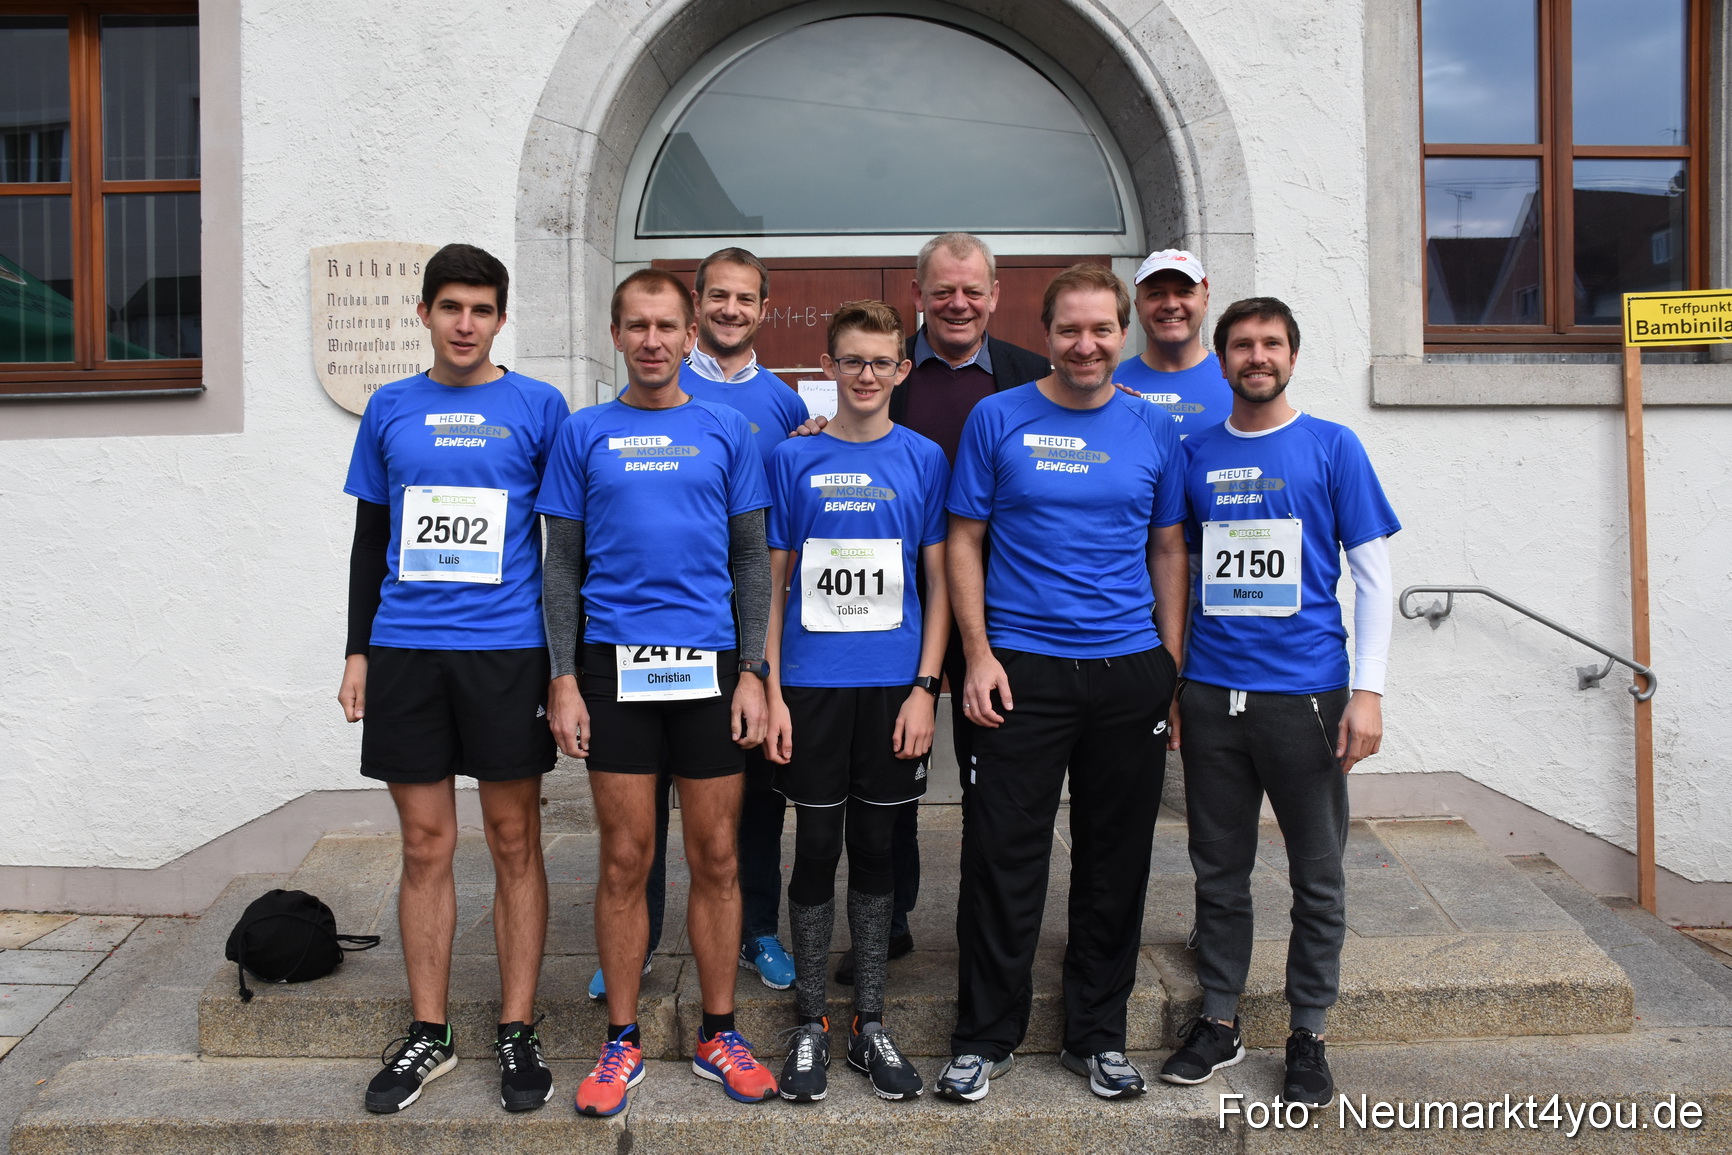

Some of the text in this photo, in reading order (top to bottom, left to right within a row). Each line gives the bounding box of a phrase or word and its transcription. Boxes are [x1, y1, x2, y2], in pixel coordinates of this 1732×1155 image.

[327, 259, 420, 278] Rathaus
[327, 293, 368, 307] Neubau
[375, 295, 389, 306] um
[1660, 301, 1732, 316] Treffpunkt
[327, 315, 420, 331] Zerstörung 1945
[328, 338, 421, 353] Wiederaufbau 1957
[327, 361, 421, 376] Generalsanierung
[439, 414, 476, 423] HEUTE
[448, 425, 502, 436] MORGEN
[434, 437, 486, 448] BEWEGEN
[623, 437, 662, 446] HEUTE
[1038, 436, 1076, 448] HEUTE
[636, 447, 690, 456] MORGEN
[1047, 448, 1101, 462] MORGEN
[625, 461, 679, 472] BEWEGEN
[1035, 460, 1089, 474] BEWEGEN
[824, 475, 862, 484] HEUTE
[1218, 469, 1254, 480] HEUTE
[1228, 480, 1277, 491] MORGEN
[836, 486, 887, 498] MORGEN
[441, 496, 476, 504] BOCK
[1215, 494, 1263, 506] BEWEGEN
[824, 501, 876, 512] BEWEGEN
[416, 516, 488, 545] 2502
[1238, 529, 1271, 537] BOCK
[840, 548, 874, 556] BOCK
[438, 554, 460, 564] Luis
[1216, 550, 1285, 578] 2150
[816, 568, 884, 596] 4011
[1233, 589, 1264, 599] Marco
[836, 606, 868, 615] Tobias
[648, 672, 691, 684] Christian
